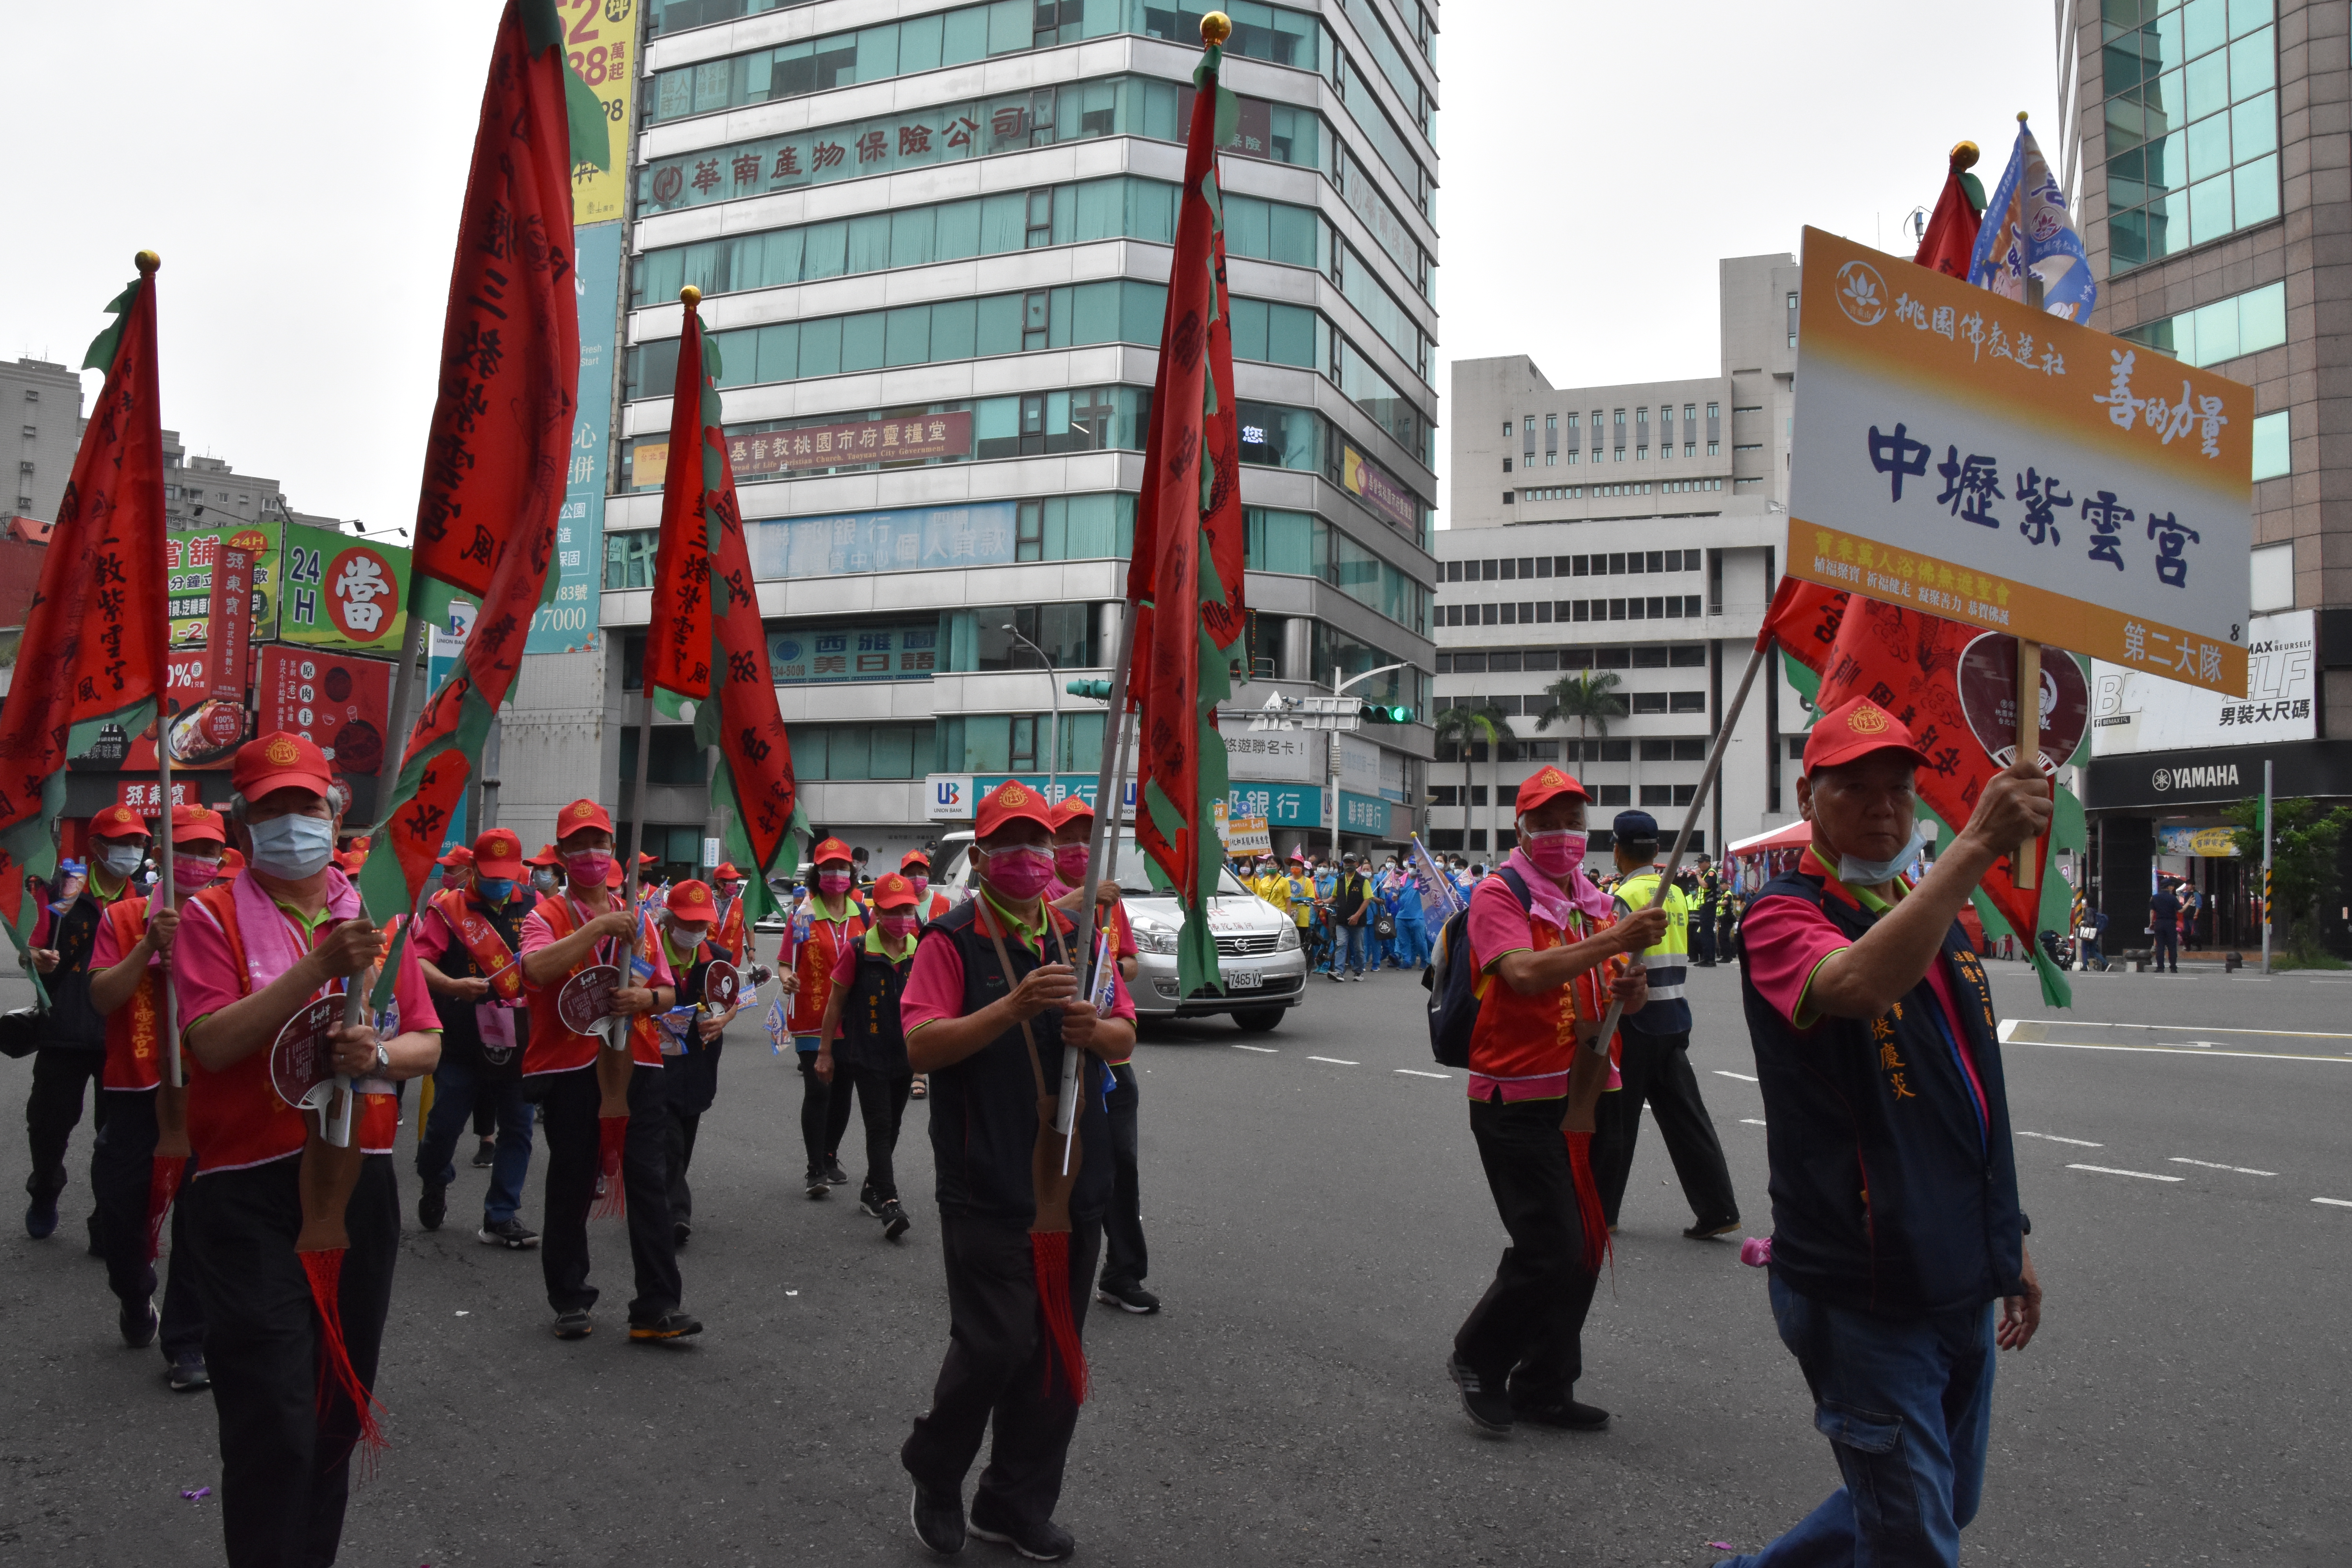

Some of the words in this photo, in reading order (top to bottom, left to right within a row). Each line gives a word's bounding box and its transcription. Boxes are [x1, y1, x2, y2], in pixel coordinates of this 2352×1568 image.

[608, 41, 626, 82] 萬起
[691, 107, 1025, 195] 華南產物保險公司
[1895, 292, 2066, 376] 桃園佛教蓮社
[580, 356, 599, 367] Start
[581, 344, 602, 355] Fresh
[2093, 348, 2228, 459] 善的力量
[730, 420, 946, 462] 基督教桃園市府靈糧堂
[1242, 425, 1263, 443] 您
[780, 458, 813, 467] Christian
[847, 451, 877, 461] Taoyuan
[880, 449, 896, 458] City
[899, 445, 945, 456] Government
[1868, 422, 2201, 589] 中壢紫雲宮
[231, 536, 264, 547] 24H
[766, 517, 891, 550] 聯邦銀行
[290, 546, 320, 585] 24
[226, 552, 246, 615] 孫東寶
[336, 555, 390, 633] 當
[1814, 556, 1860, 584] 植福聚寶
[1866, 571, 1911, 598] 祈福健走
[1918, 586, 1962, 612] 凝聚善力
[1967, 600, 2009, 626] 恭賀佛誕
[293, 586, 316, 624] H
[541, 607, 586, 632] 7000
[2230, 623, 2240, 641] 8
[225, 621, 235, 675] 台式牛排教父
[815, 631, 936, 653] 西雅圖
[2123, 621, 2223, 683] 第二大隊
[2274, 639, 2312, 652] BEURSELF
[192, 664, 201, 675] 原
[813, 652, 935, 674] 美日語
[287, 705, 294, 722] 味道
[2102, 717, 2120, 726] BEMAX
[2219, 699, 2310, 726] 男裝大尺碼
[2172, 764, 2239, 789] YAMAHA
[126, 783, 185, 806] 孫東寶
[1348, 800, 1381, 829] 聯邦銀行
[807, 929, 824, 1011] 三教紫雲宮
[1230, 973, 1262, 986] 7465-VX
